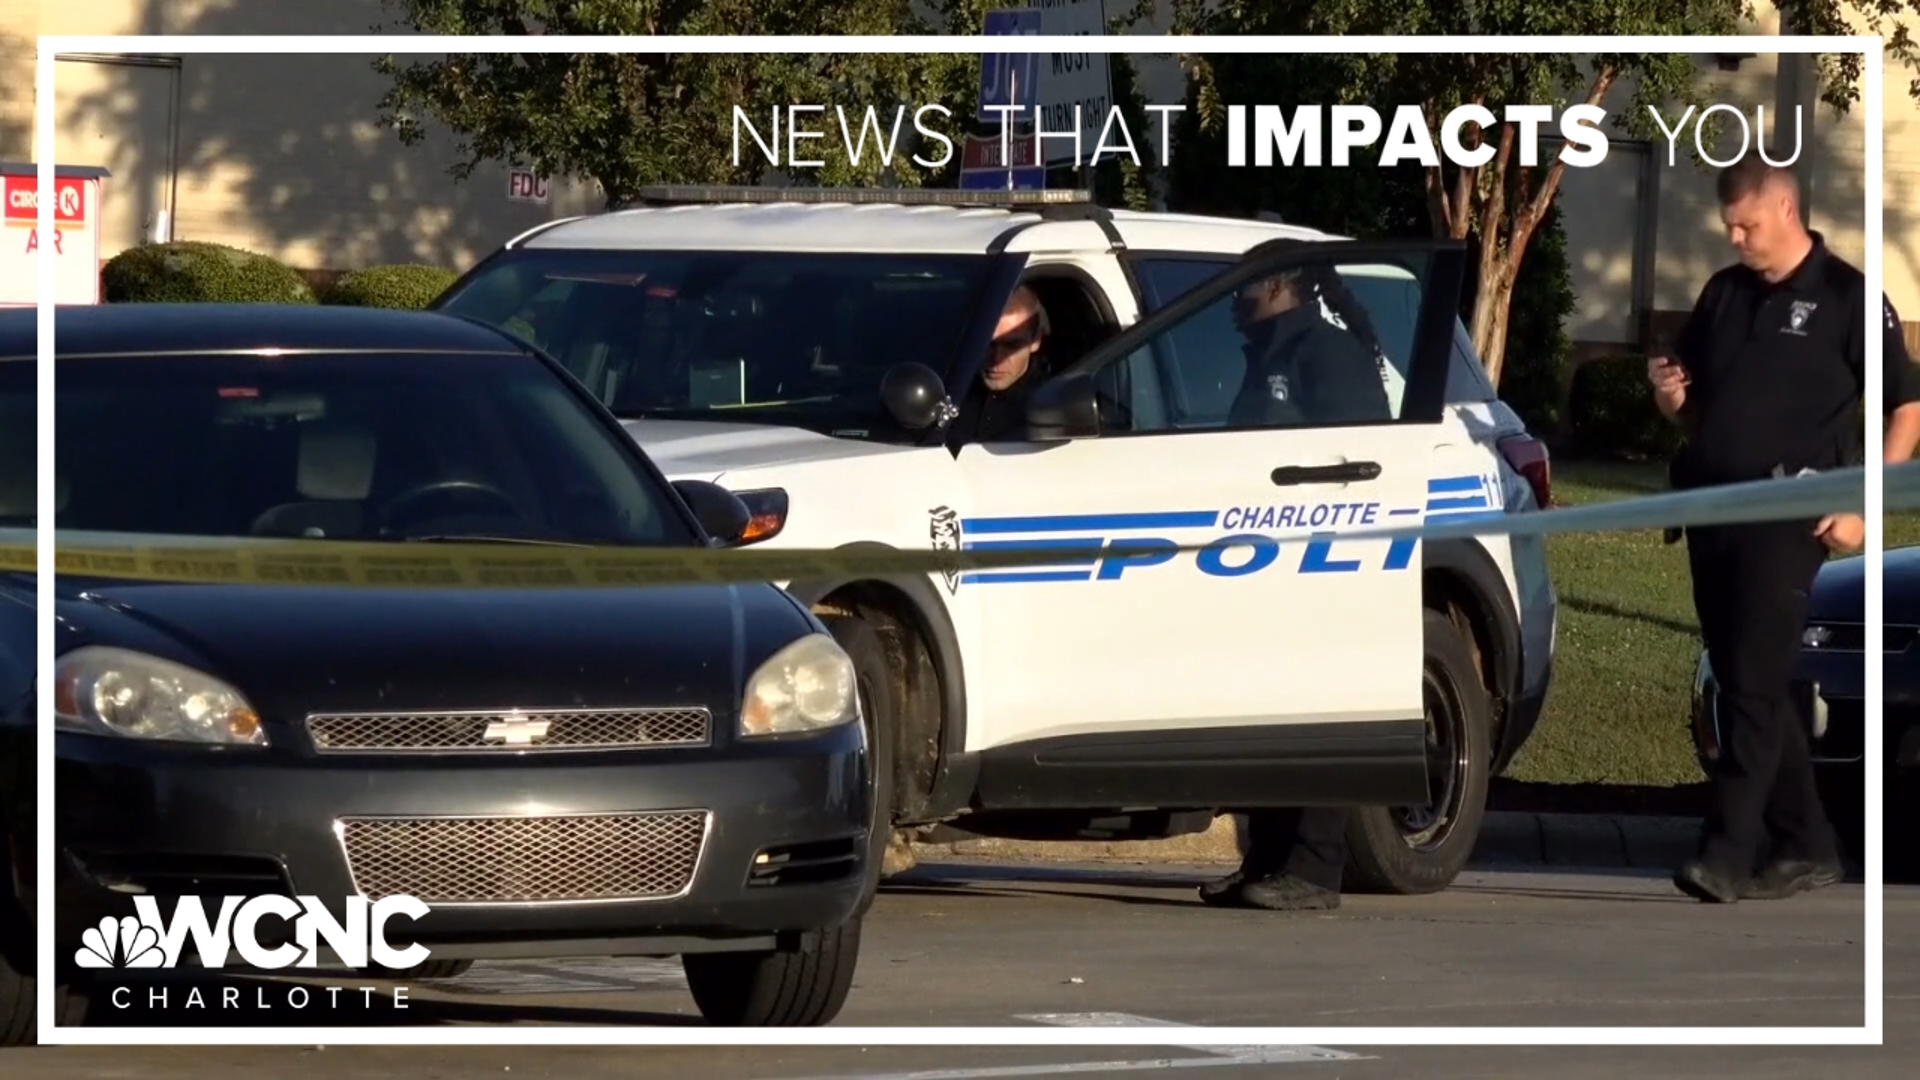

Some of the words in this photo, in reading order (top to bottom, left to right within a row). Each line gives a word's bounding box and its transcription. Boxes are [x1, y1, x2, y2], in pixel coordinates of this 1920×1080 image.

[1041, 102, 1074, 132] TURN
[1075, 96, 1107, 131] IGHT
[510, 172, 547, 198] FDC
[26, 228, 63, 254] AR
[1222, 503, 1380, 530] CHARLOTTE
